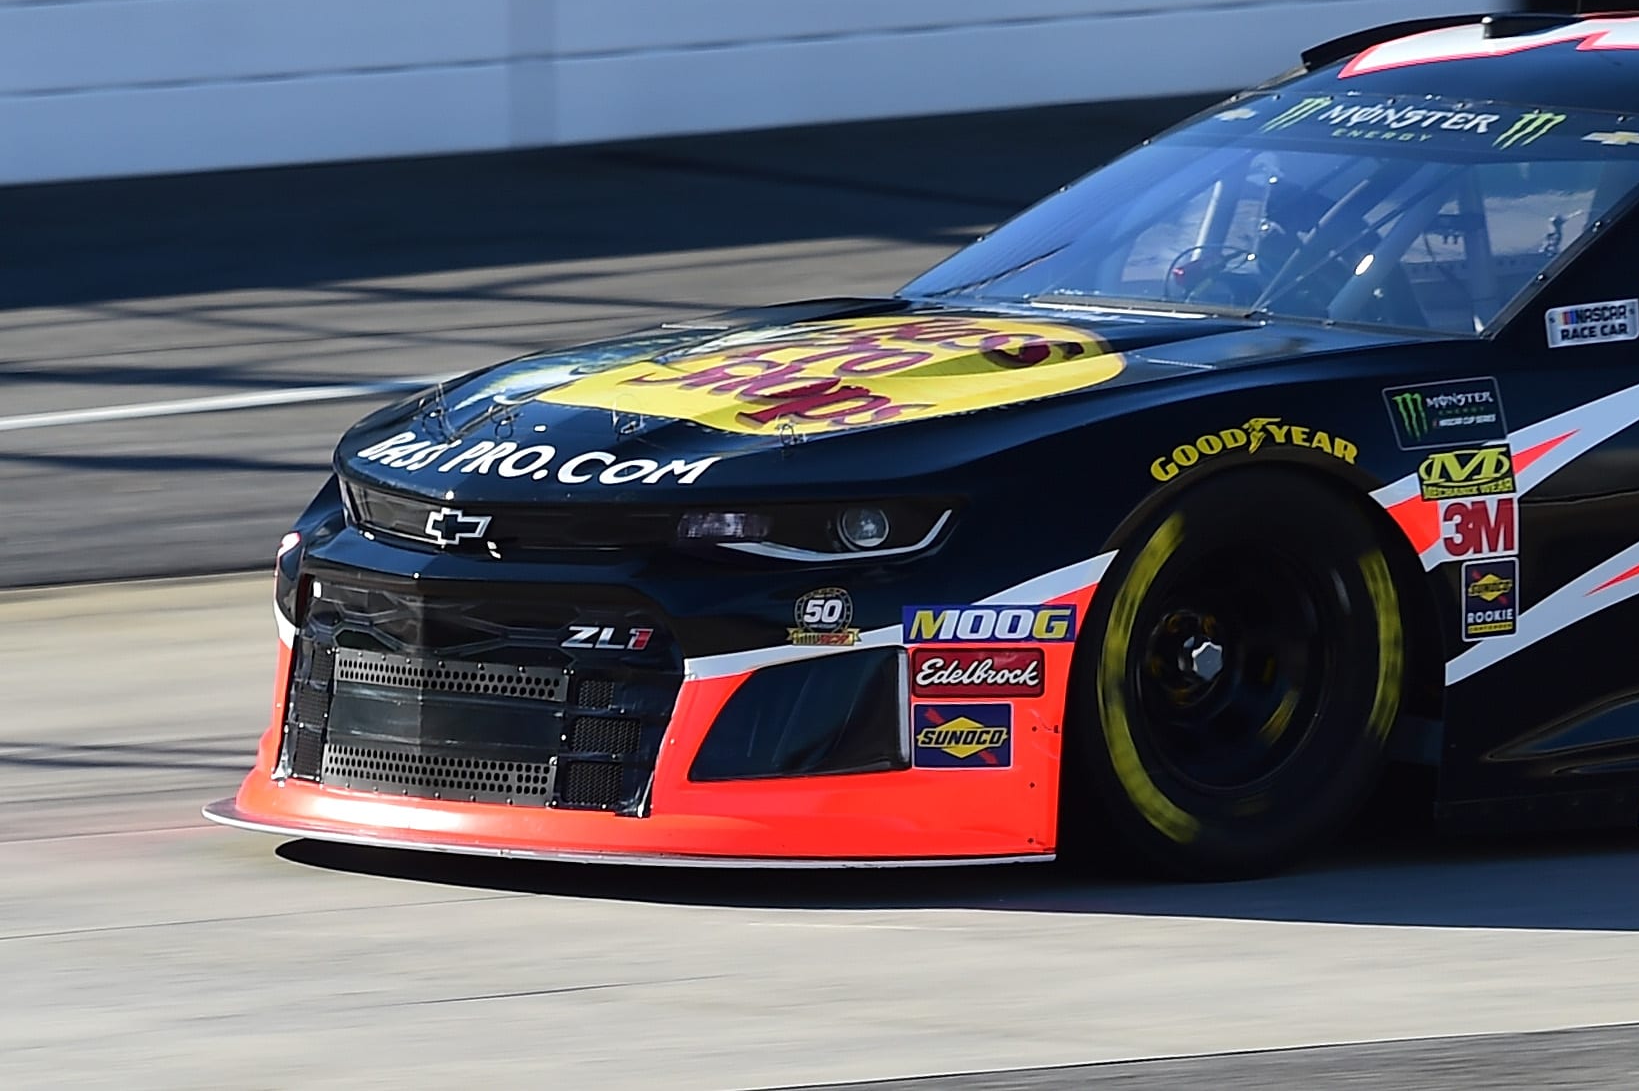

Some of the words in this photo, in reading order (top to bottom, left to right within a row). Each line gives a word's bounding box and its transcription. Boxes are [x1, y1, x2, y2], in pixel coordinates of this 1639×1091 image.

[1318, 104, 1500, 133] MONSTER
[1332, 128, 1432, 141] ENERGY
[1576, 305, 1627, 323] NASCAR
[1561, 326, 1597, 341] RACE
[1600, 323, 1628, 336] CAR
[1443, 498, 1515, 557] 3M
[803, 599, 842, 623] 50
[1467, 608, 1513, 624] ROOKIE
[910, 609, 1070, 641] MOOG
[560, 626, 655, 650] ZL1
[915, 657, 1040, 687] Edelbrock
[920, 728, 1005, 749] SUNOCO
